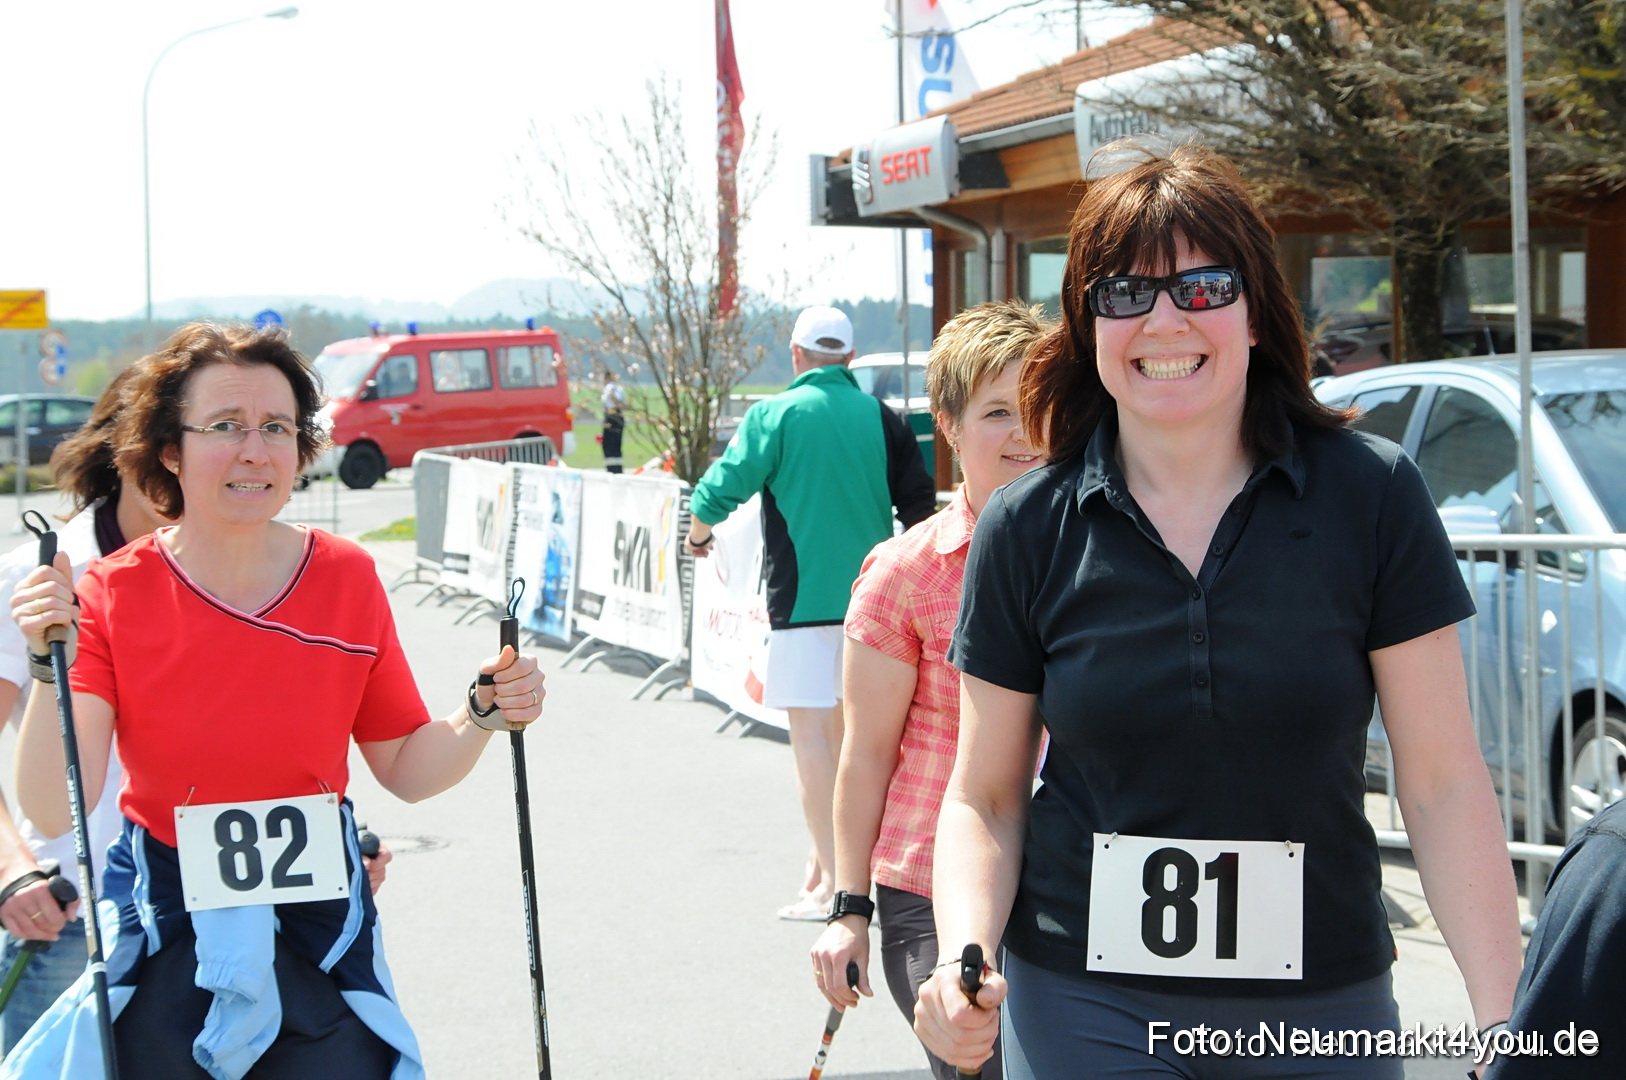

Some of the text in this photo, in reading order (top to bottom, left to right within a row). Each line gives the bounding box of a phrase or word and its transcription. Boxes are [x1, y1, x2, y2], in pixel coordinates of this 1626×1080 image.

[881, 144, 932, 185] SEAT
[213, 804, 314, 892] 82
[1141, 846, 1240, 960] 81
